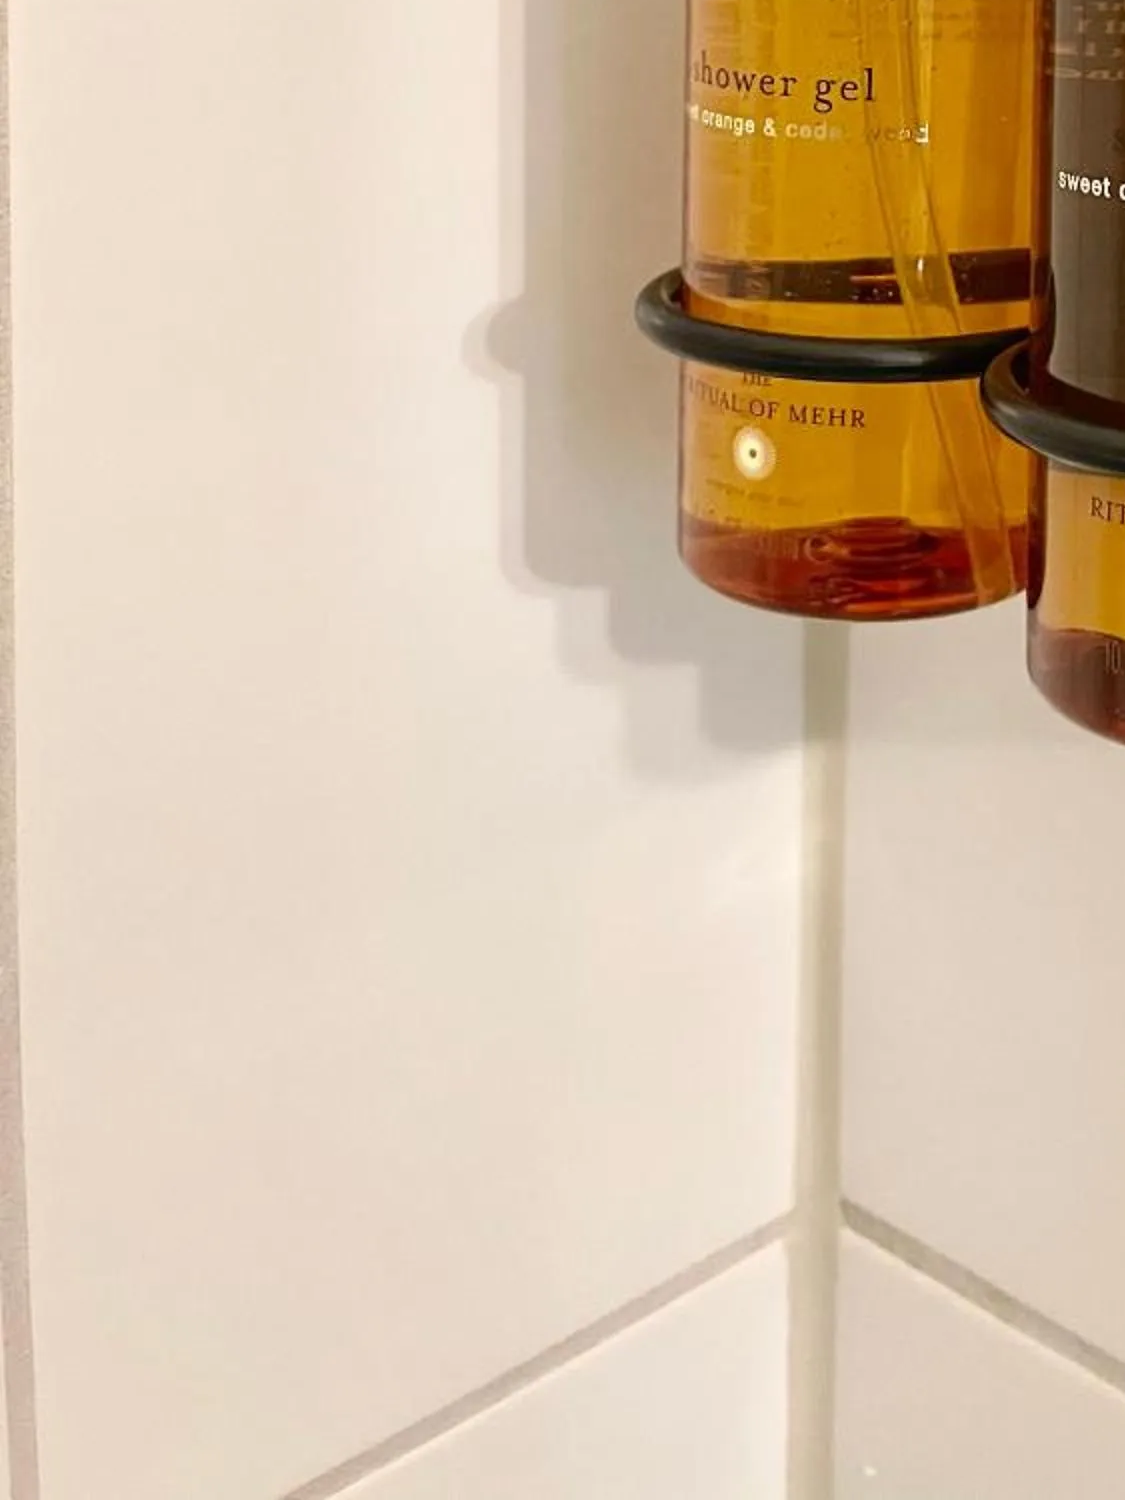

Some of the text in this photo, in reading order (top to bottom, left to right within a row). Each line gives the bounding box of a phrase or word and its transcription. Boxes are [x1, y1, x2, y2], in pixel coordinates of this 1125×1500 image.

[813, 68, 875, 113] gel
[701, 108, 756, 137] orange
[763, 116, 778, 138] &
[1058, 171, 1111, 199] sweet
[749, 399, 780, 420] OF
[788, 403, 867, 428] MEHR
